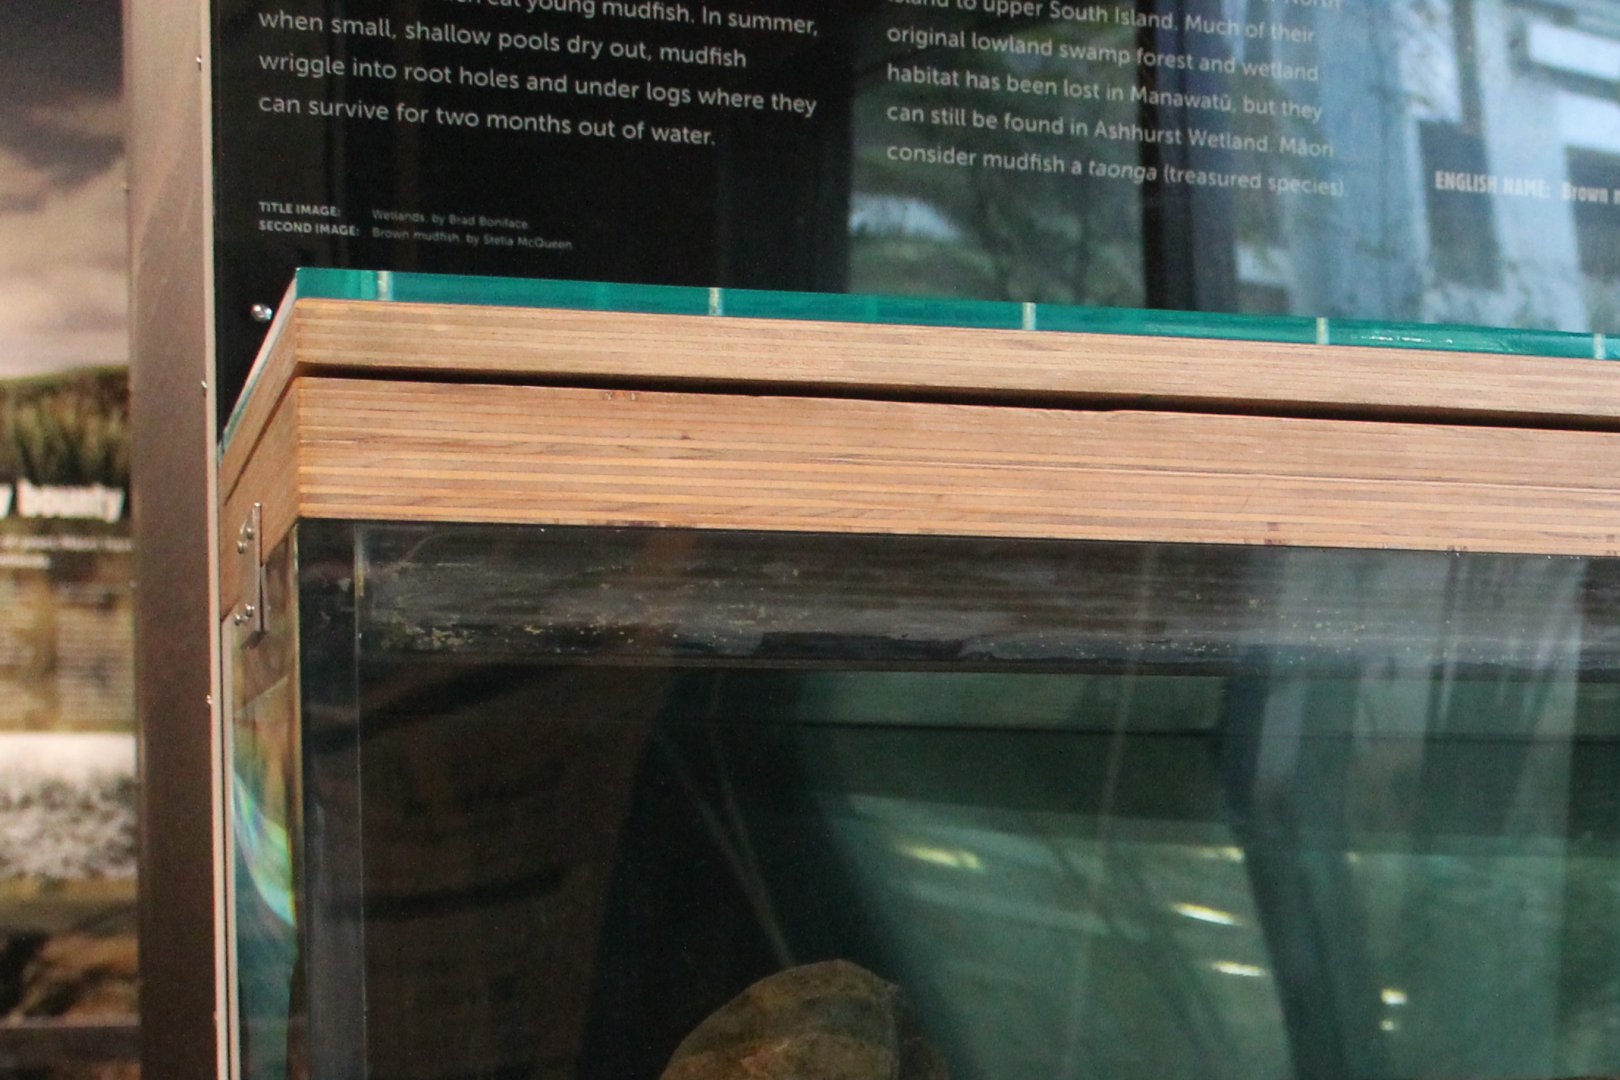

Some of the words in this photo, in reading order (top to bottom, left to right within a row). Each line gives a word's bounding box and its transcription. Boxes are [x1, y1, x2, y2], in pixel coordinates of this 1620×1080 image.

[526, 0, 595, 18] young
[603, 0, 694, 24] mudfish.
[702, 6, 721, 25] In
[728, 11, 818, 36] summer,
[983, 0, 1043, 18] upper
[1051, 2, 1108, 23] South
[1115, 6, 1177, 31] Island.
[1185, 15, 1239, 35] Much
[1245, 22, 1265, 39] of
[1271, 22, 1314, 43] their
[258, 10, 323, 32] when
[331, 18, 397, 39] small,
[405, 21, 491, 46] shallow
[498, 32, 560, 51] pools
[567, 35, 602, 59] dry
[610, 41, 652, 61] out,
[659, 46, 746, 67] mudfish
[887, 26, 965, 49] original
[971, 32, 1052, 56] lowland
[1059, 44, 1130, 68] swamp
[1136, 47, 1193, 70] forest
[1199, 55, 1235, 74] and
[1242, 61, 1319, 81] wetland
[259, 53, 345, 78] wriggle
[353, 57, 397, 79] into
[404, 65, 452, 84] root
[459, 66, 519, 90] holes
[526, 74, 567, 93] and
[575, 78, 640, 99] under
[647, 82, 691, 107] logs
[697, 88, 764, 110] where
[771, 92, 817, 118] they
[887, 63, 960, 87] habitat
[966, 69, 1000, 91] has
[1006, 75, 1057, 96] been
[1063, 79, 1099, 99] lost
[1106, 86, 1124, 101] in
[1243, 95, 1275, 115] but
[1281, 98, 1322, 124] they
[259, 96, 300, 113] can
[309, 99, 389, 120] survive
[397, 103, 428, 122] for
[436, 107, 478, 127] two
[487, 112, 571, 134] months
[578, 119, 616, 138] out
[622, 121, 645, 140] of
[652, 125, 715, 145] water.
[887, 106, 924, 123] can
[931, 106, 966, 126] still
[972, 110, 998, 130] be
[1004, 112, 1063, 135] found
[1070, 119, 1088, 136] in
[1094, 119, 1182, 145] Ashhurst
[887, 145, 977, 166] consider
[982, 151, 1065, 173] mudfish
[1070, 160, 1082, 175] a
[1089, 160, 1157, 184] taonga
[1164, 163, 1261, 189] (treasured
[1435, 170, 1497, 194] ENGLISH
[1503, 176, 1551, 199] NAME:
[258, 201, 293, 214] TITLE
[296, 203, 341, 217] IMAGE:
[1562, 181, 1608, 203] Brown
[258, 219, 312, 234] SECOND
[315, 223, 360, 237] IMAGE:
[372, 227, 409, 239] Brown
[466, 234, 480, 247] by
[431, 213, 446, 226] by
[449, 214, 476, 226] Brad
